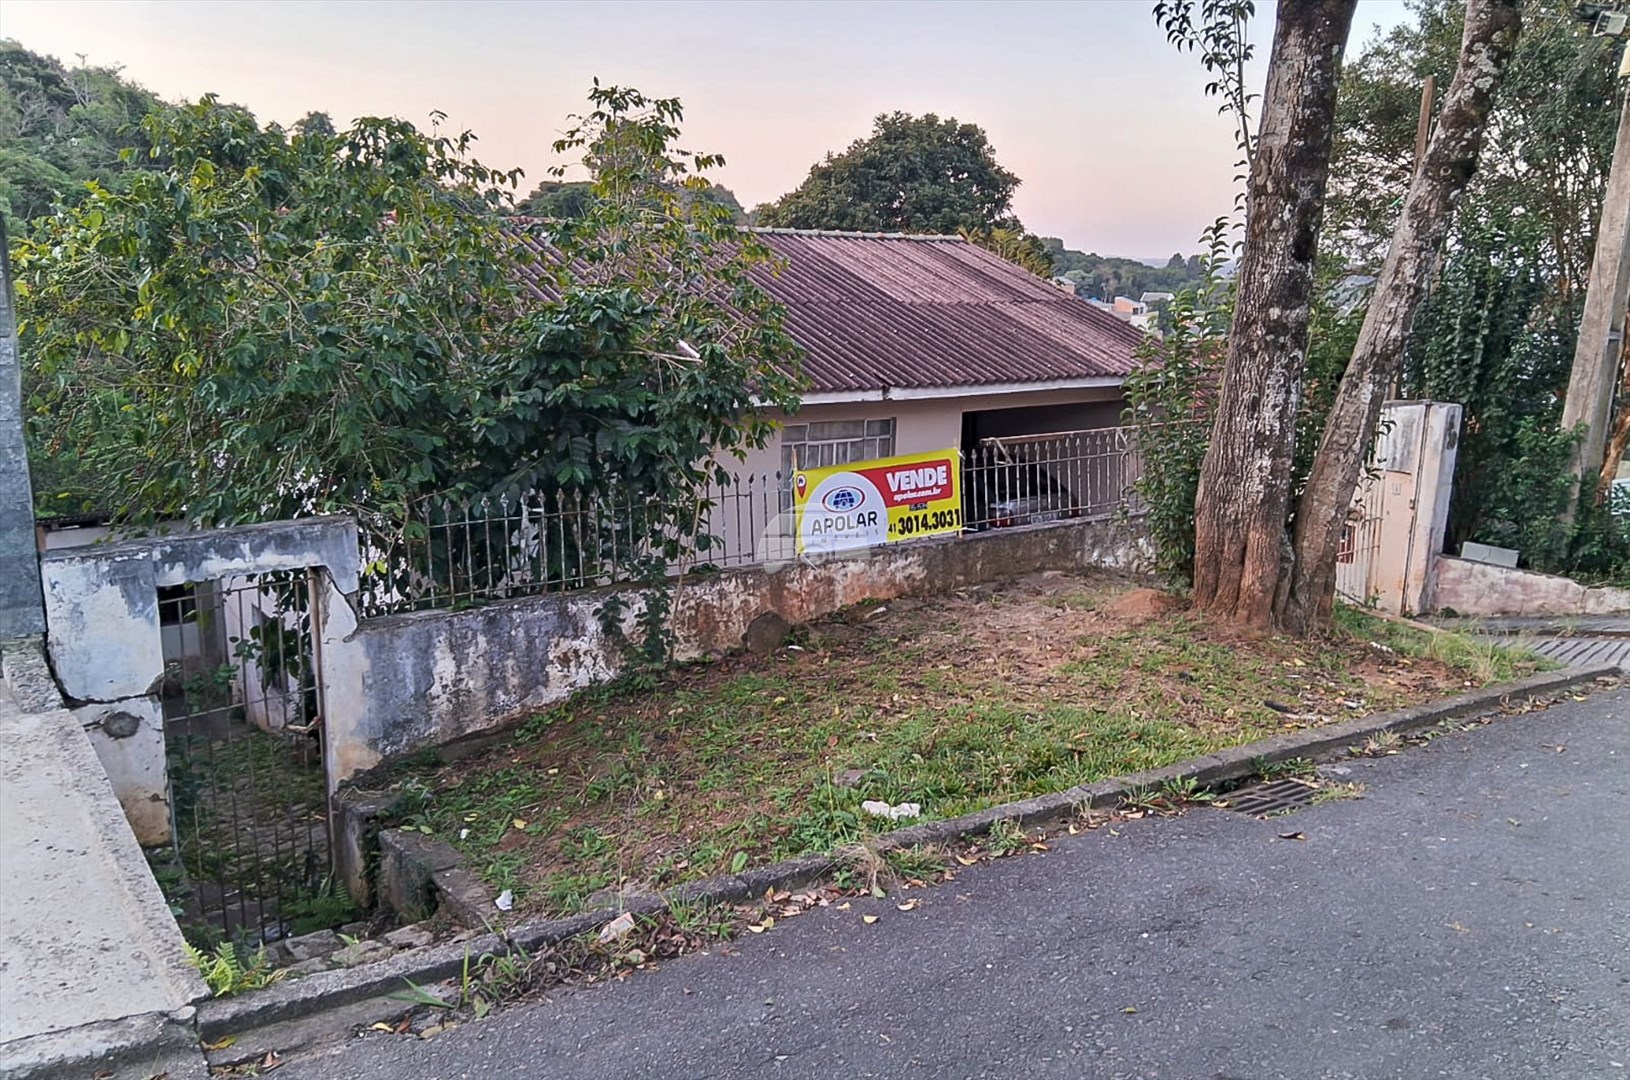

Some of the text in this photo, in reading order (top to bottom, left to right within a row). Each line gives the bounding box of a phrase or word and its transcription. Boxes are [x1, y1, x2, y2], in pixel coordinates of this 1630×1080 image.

[886, 465, 947, 492] VENDE
[811, 510, 878, 536] APOLAR
[888, 508, 961, 535] 41 3014.3031
